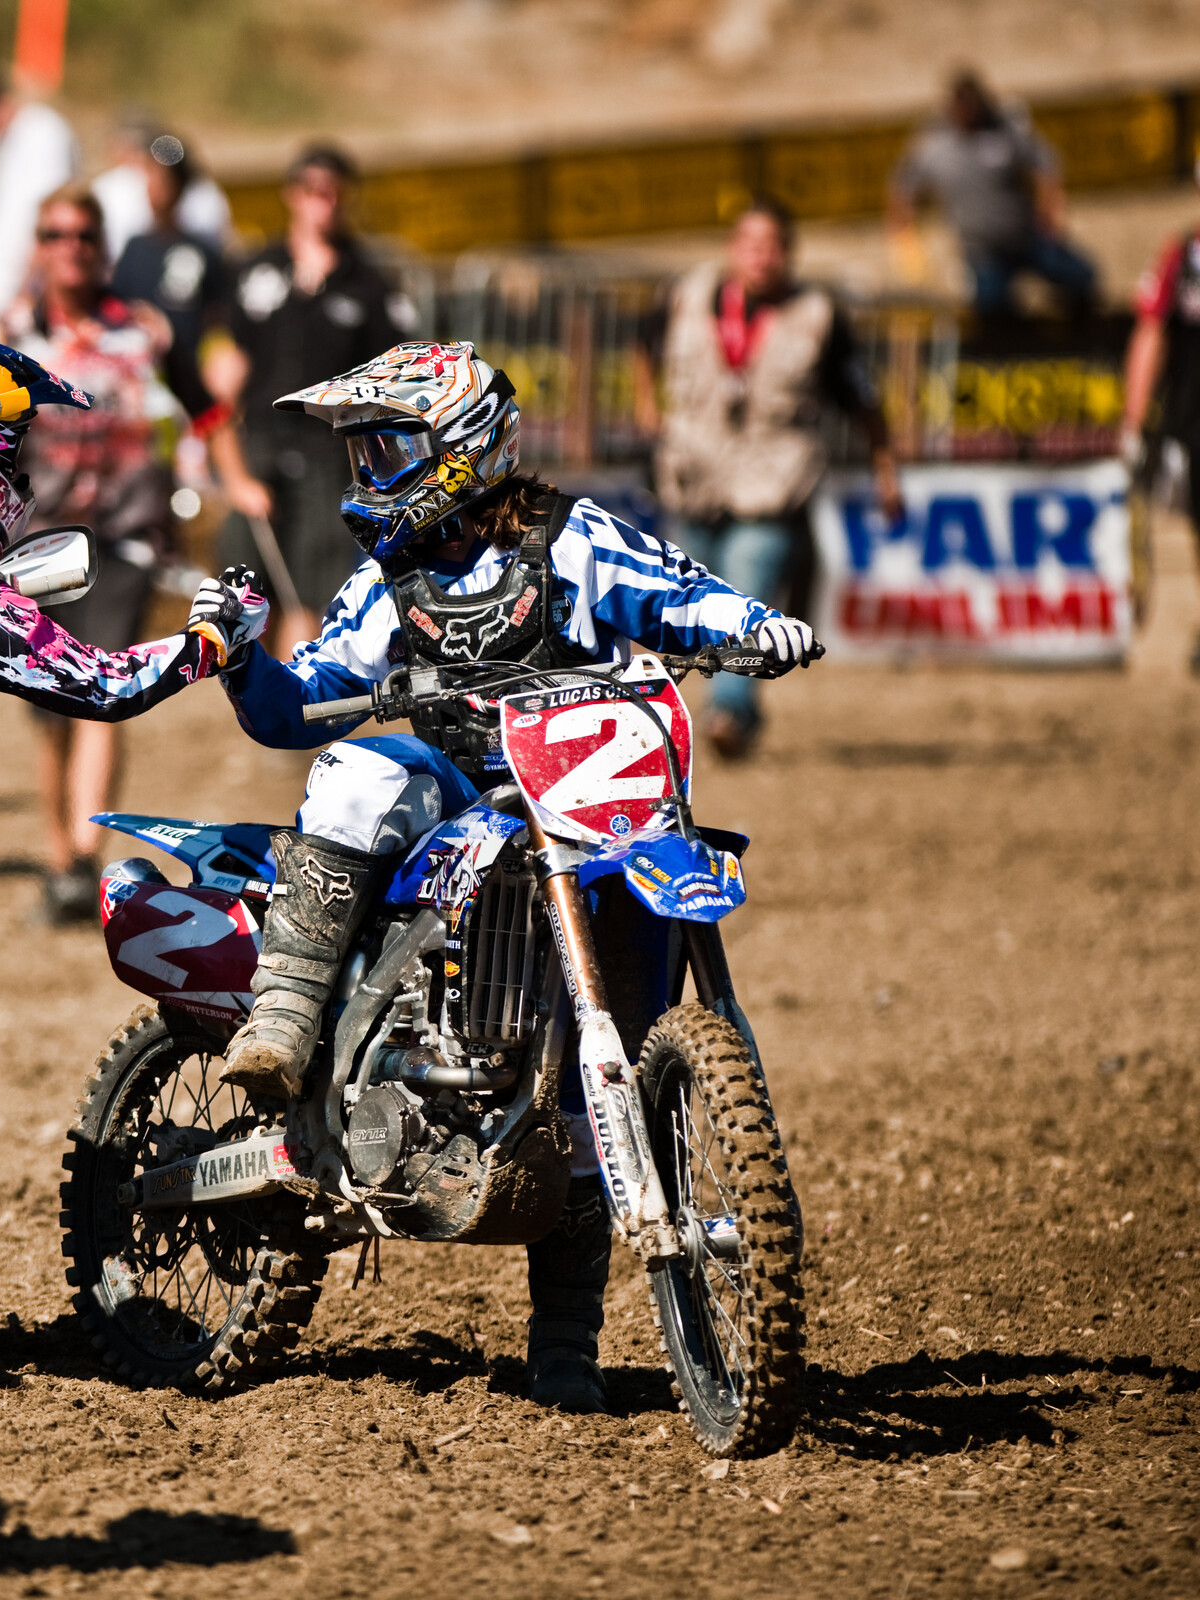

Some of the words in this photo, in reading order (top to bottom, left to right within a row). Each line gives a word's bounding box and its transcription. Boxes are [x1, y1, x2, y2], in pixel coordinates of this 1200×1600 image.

[407, 489, 453, 525] DNA
[414, 512, 438, 531] ENERGY
[438, 499, 458, 515] DRINK
[844, 488, 1125, 571] PAR
[549, 686, 602, 708] LUCAS
[313, 750, 343, 767] FOX
[539, 701, 673, 814] 2
[677, 895, 735, 913] YAMAHA
[117, 890, 238, 990] 2
[185, 1004, 233, 1021] PATTERSON
[351, 1127, 388, 1142] GYTR
[199, 1149, 269, 1187] YAMAHA
